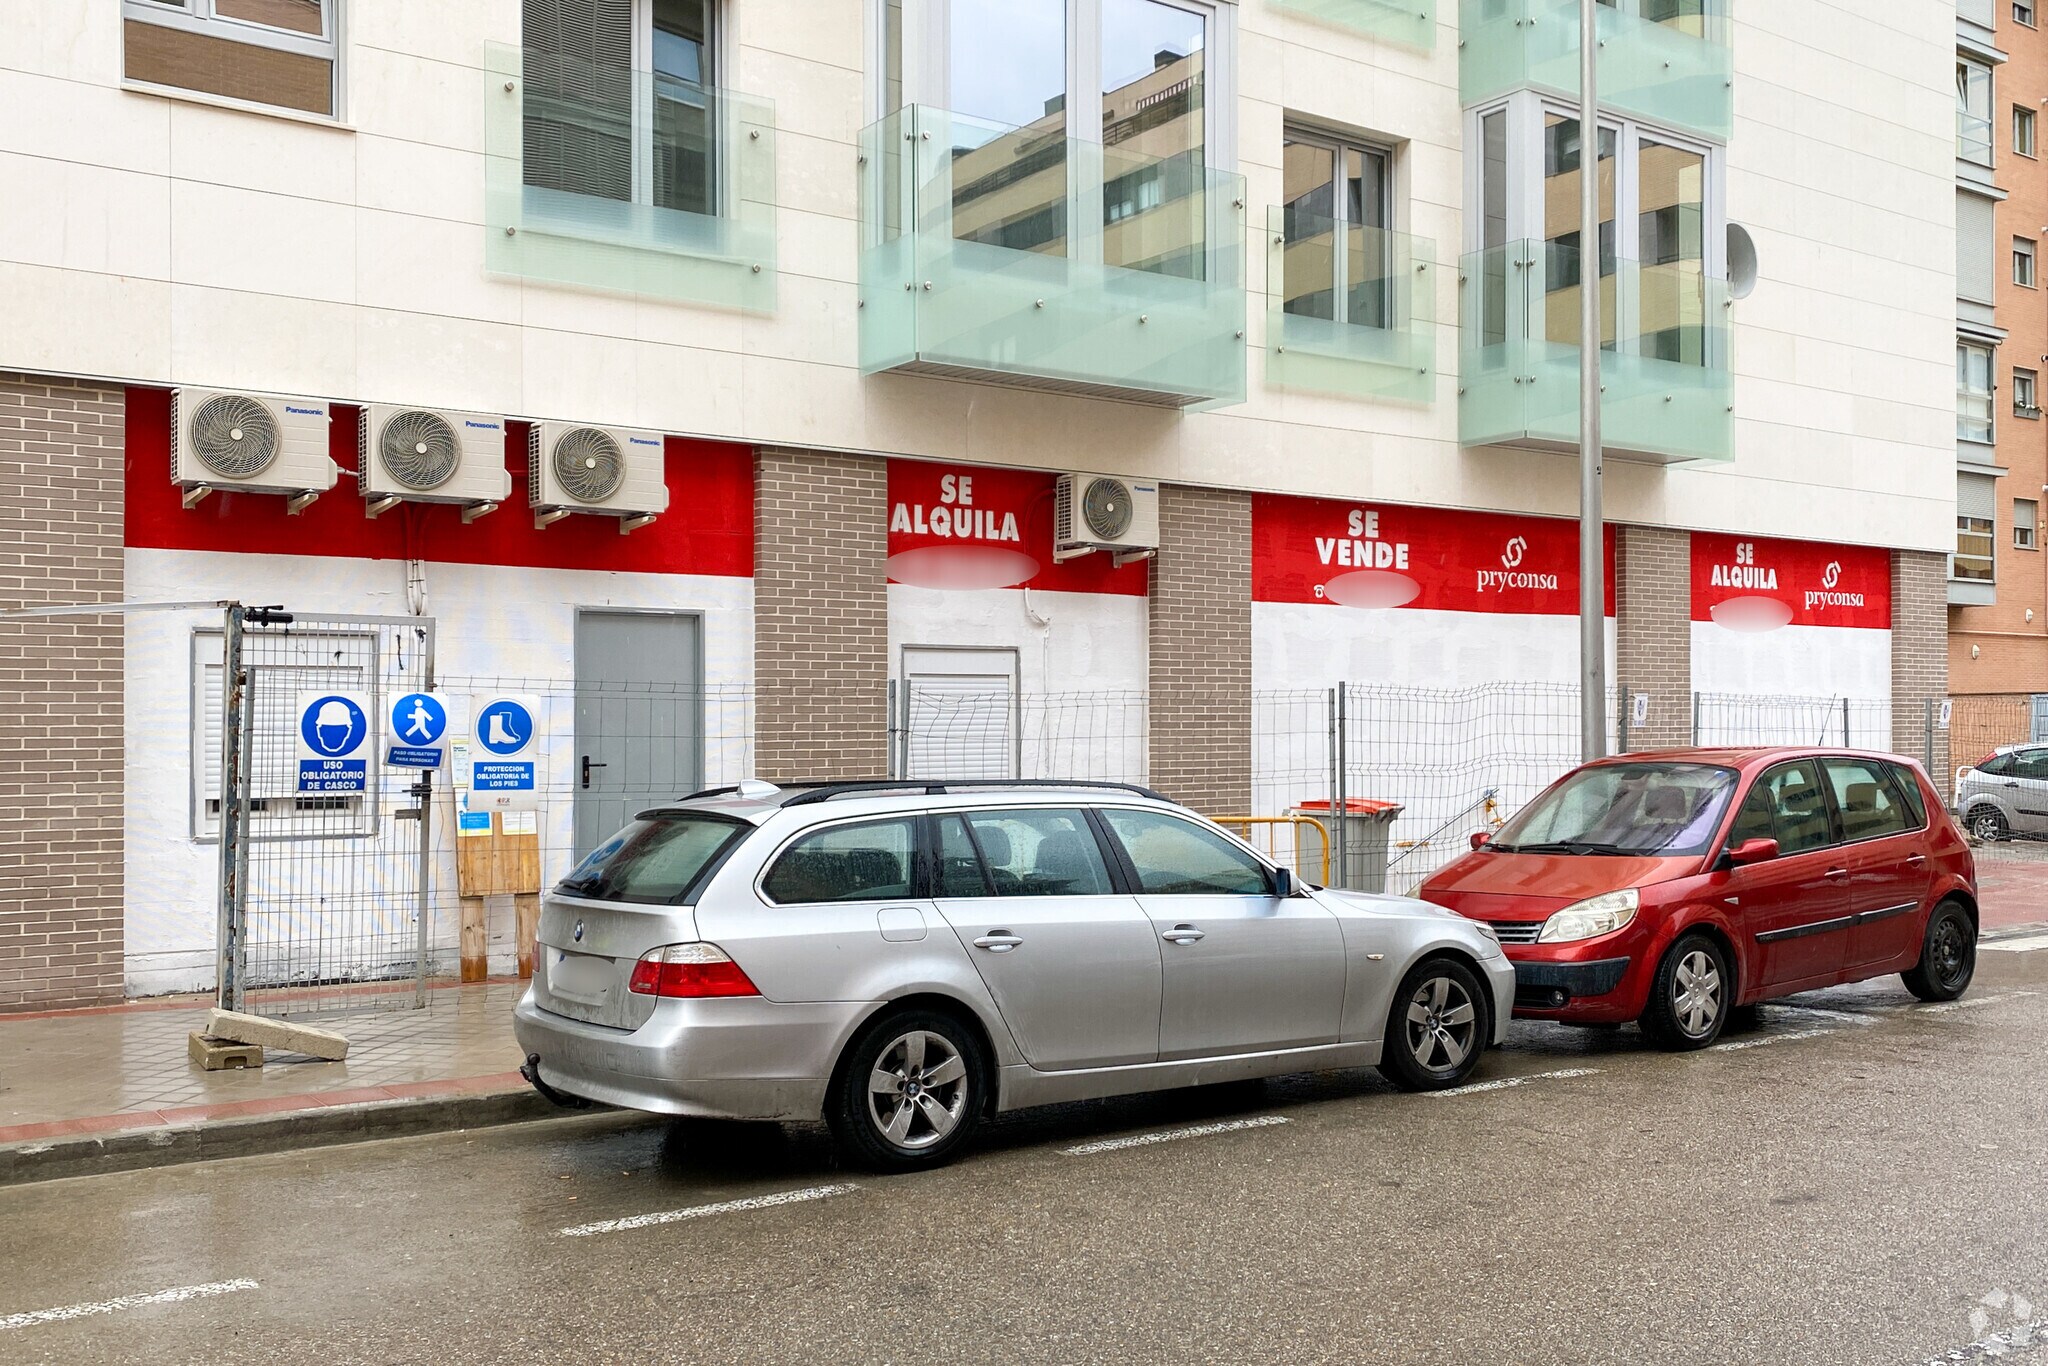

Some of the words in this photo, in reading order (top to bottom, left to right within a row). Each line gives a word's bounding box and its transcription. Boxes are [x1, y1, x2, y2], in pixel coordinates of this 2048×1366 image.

[286, 406, 323, 416] Panasonic
[466, 420, 500, 430] Panasonic
[630, 437, 660, 446] Panasonic
[940, 474, 973, 505] SE
[890, 502, 1020, 542] ALQUILA
[1347, 509, 1379, 538] SE
[1315, 537, 1409, 570] VENDE
[1736, 542, 1754, 565] SE
[1476, 570, 1558, 593] pryconsa
[1711, 564, 1778, 590] ALQUILA
[1805, 590, 1865, 610] pryconsa
[301, 771, 364, 780] OBLIGATORIO
[323, 761, 344, 770] USO
[307, 781, 320, 790] DE
[324, 781, 357, 790] CASCO
